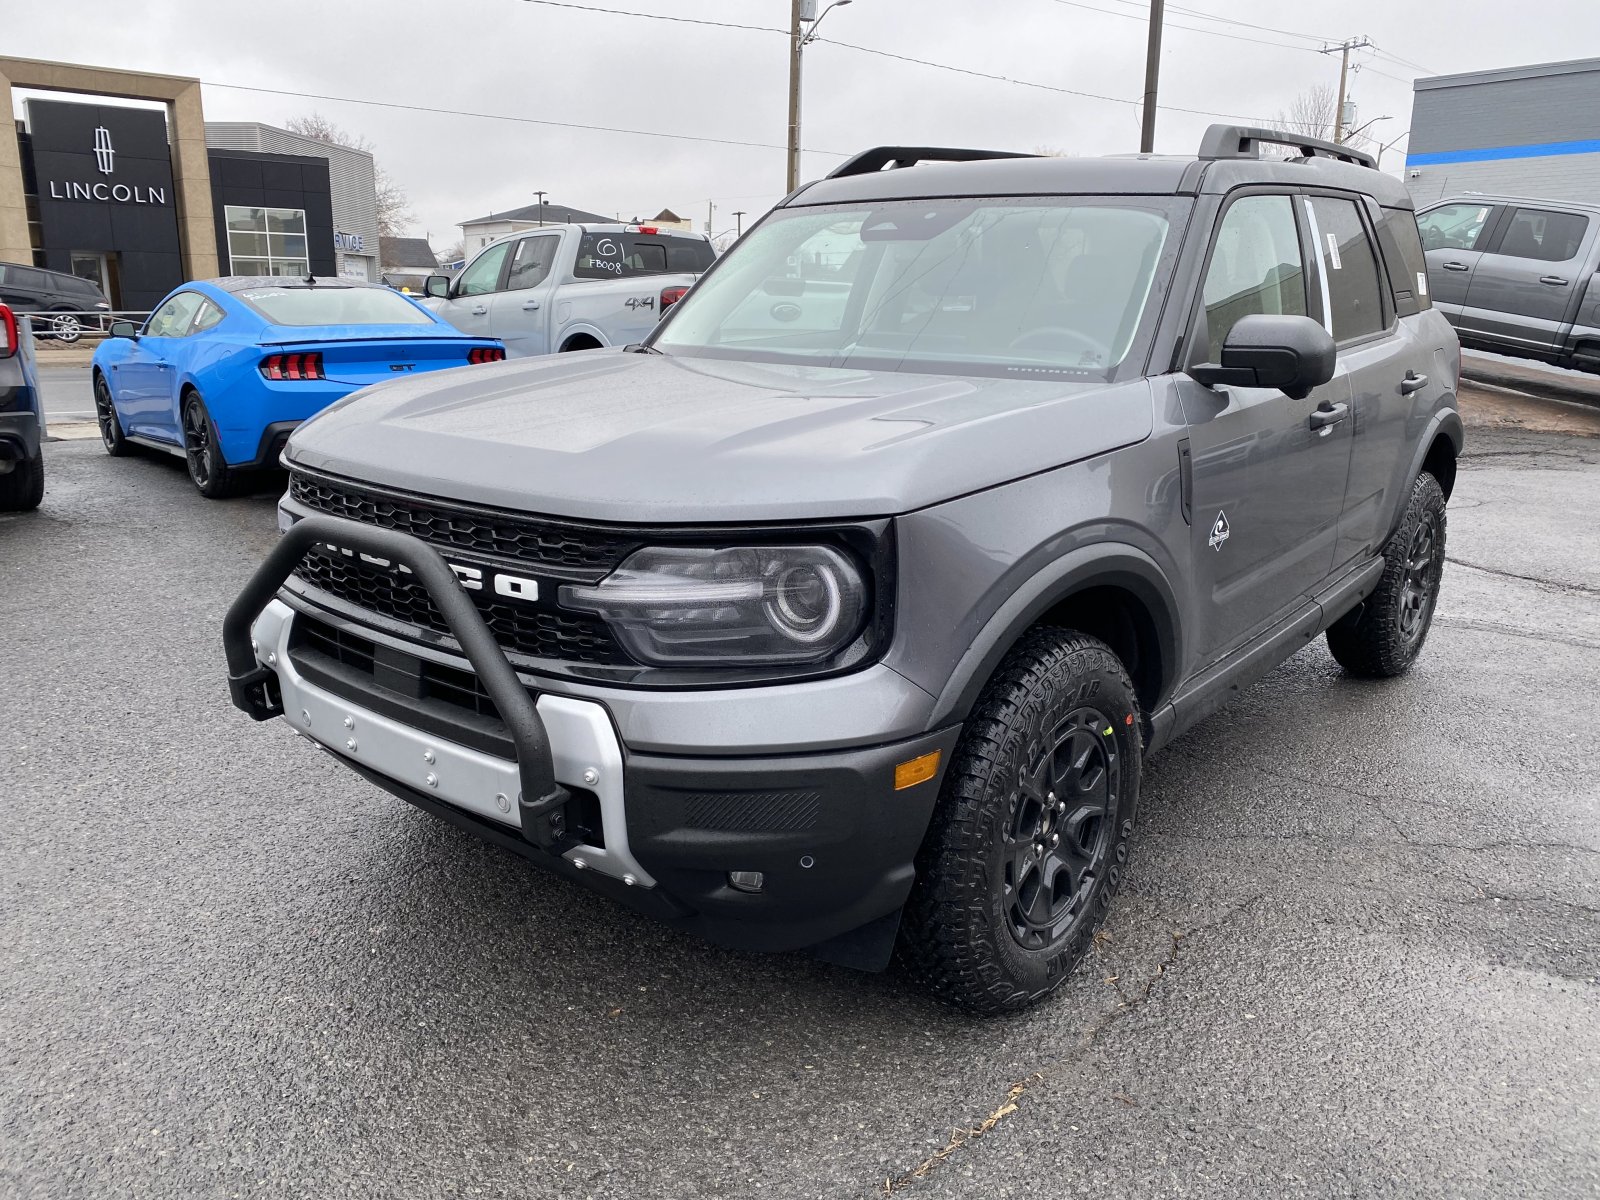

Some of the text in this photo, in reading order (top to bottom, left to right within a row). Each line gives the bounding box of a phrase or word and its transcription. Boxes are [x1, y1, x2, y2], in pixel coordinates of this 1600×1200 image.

[50, 180, 165, 204] LINCOLN
[334, 233, 363, 250] RVICE
[589, 258, 623, 275] FB008
[389, 363, 416, 372] GT
